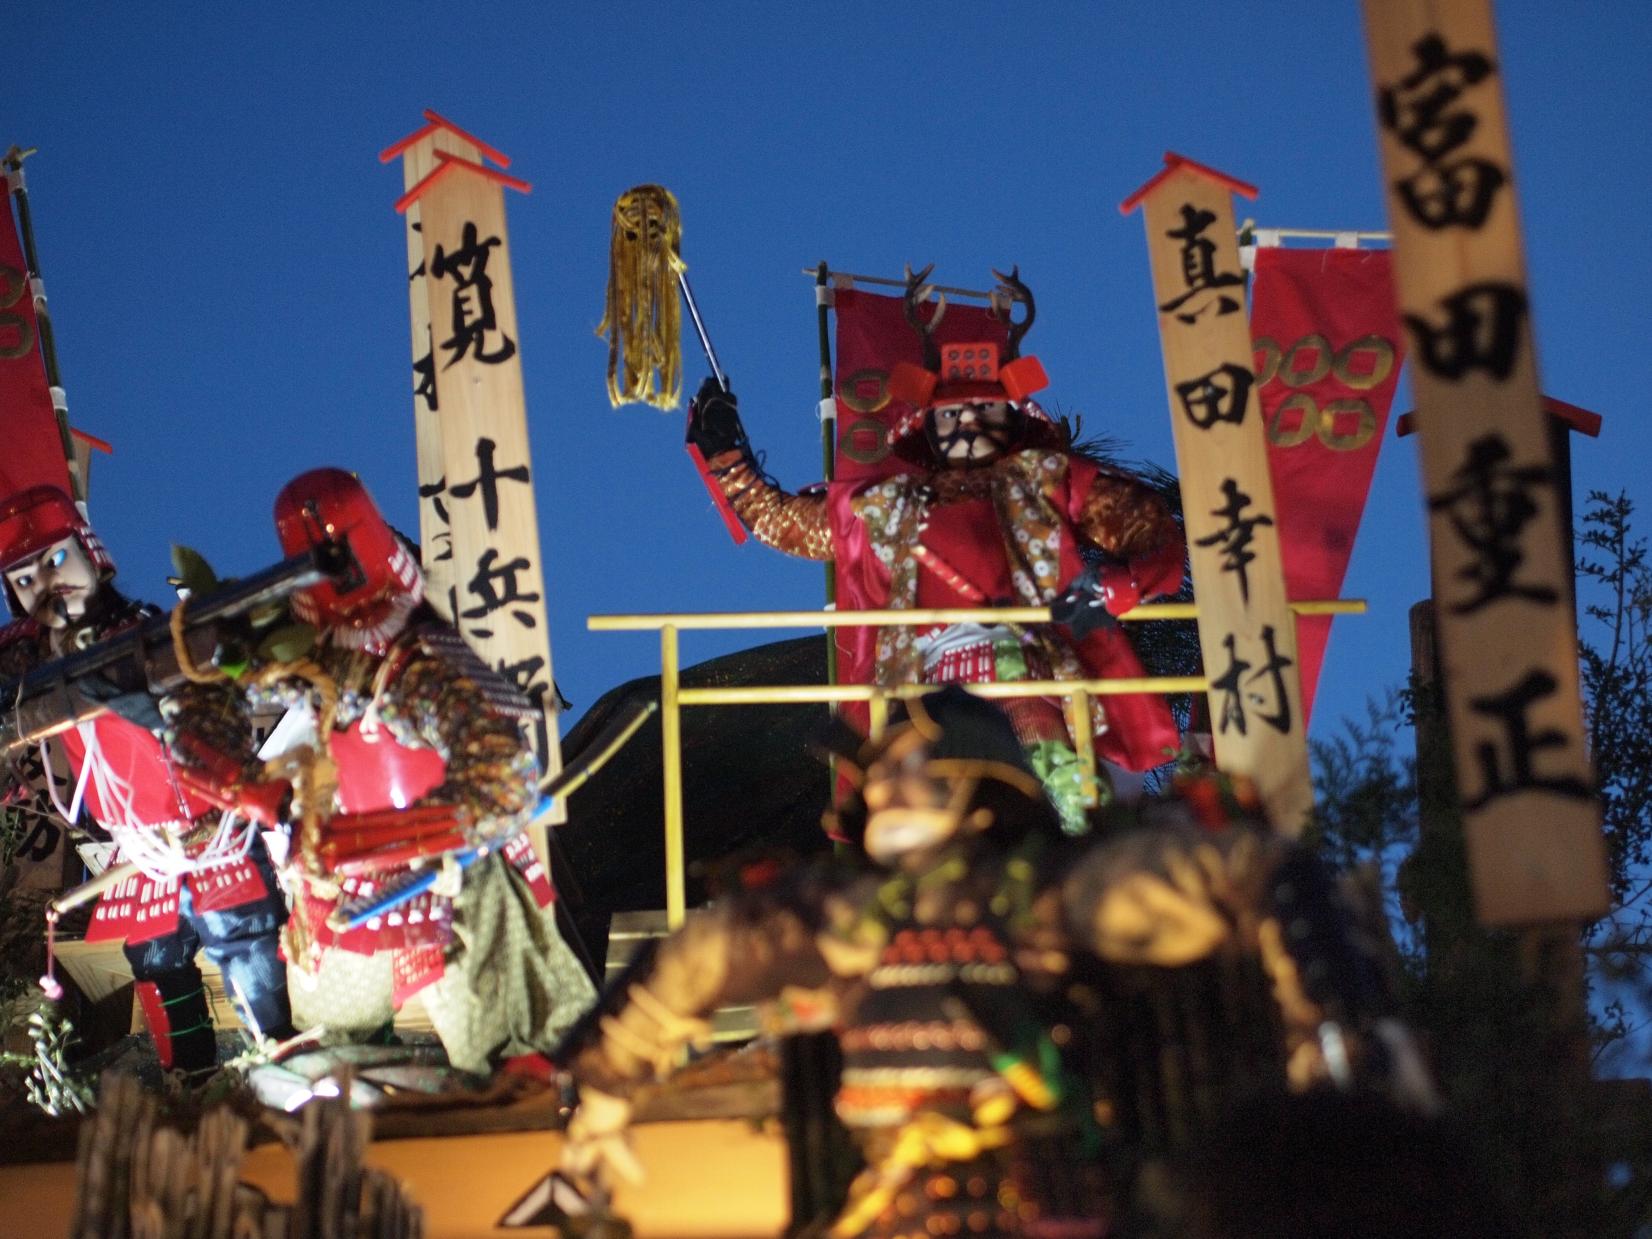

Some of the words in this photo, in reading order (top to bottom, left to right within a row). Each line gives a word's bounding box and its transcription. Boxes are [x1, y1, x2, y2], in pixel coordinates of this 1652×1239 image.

[1159, 203, 1292, 736] 真田幸村
[1379, 33, 1596, 811] 富田重正
